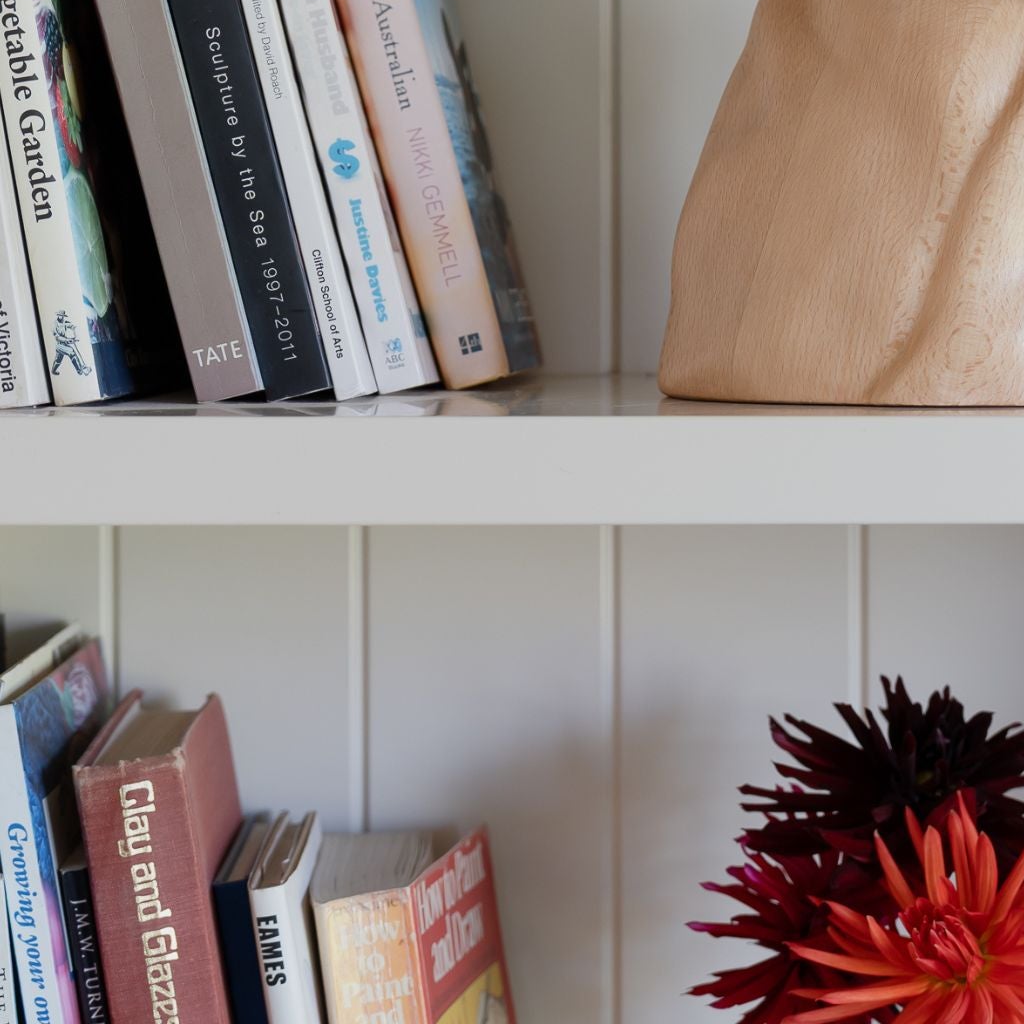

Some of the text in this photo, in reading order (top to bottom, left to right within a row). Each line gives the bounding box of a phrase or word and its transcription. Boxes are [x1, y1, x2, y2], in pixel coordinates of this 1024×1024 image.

[256, 17, 267, 35] by
[261, 35, 276, 67] David
[309, 8, 350, 117] Husband
[372, 0, 416, 111] Australian
[268, 66, 284, 100] Roach
[18, 108, 57, 224] Garden
[205, 26, 240, 127] Sculpture
[230, 134, 246, 159] by
[239, 168, 256, 200] the
[249, 209, 268, 248] Sea
[406, 127, 462, 288] NIKKI GEMMELL
[349, 198, 389, 323] Justine Davies
[312, 249, 344, 359] Clifton School of Arts
[0, 322, 16, 393] Victoria
[192, 339, 244, 368] TATE
[385, 353, 406, 365] ABC
[8, 822, 38, 928] Growing
[118, 780, 180, 1024] Clay and Glaze
[417, 841, 485, 934] How to Paint
[18, 932, 46, 990] your
[69, 899, 95, 959] J.M.W.
[256, 914, 287, 987] EAMES
[431, 902, 485, 983] and Draw
[341, 976, 413, 1009] Paint
